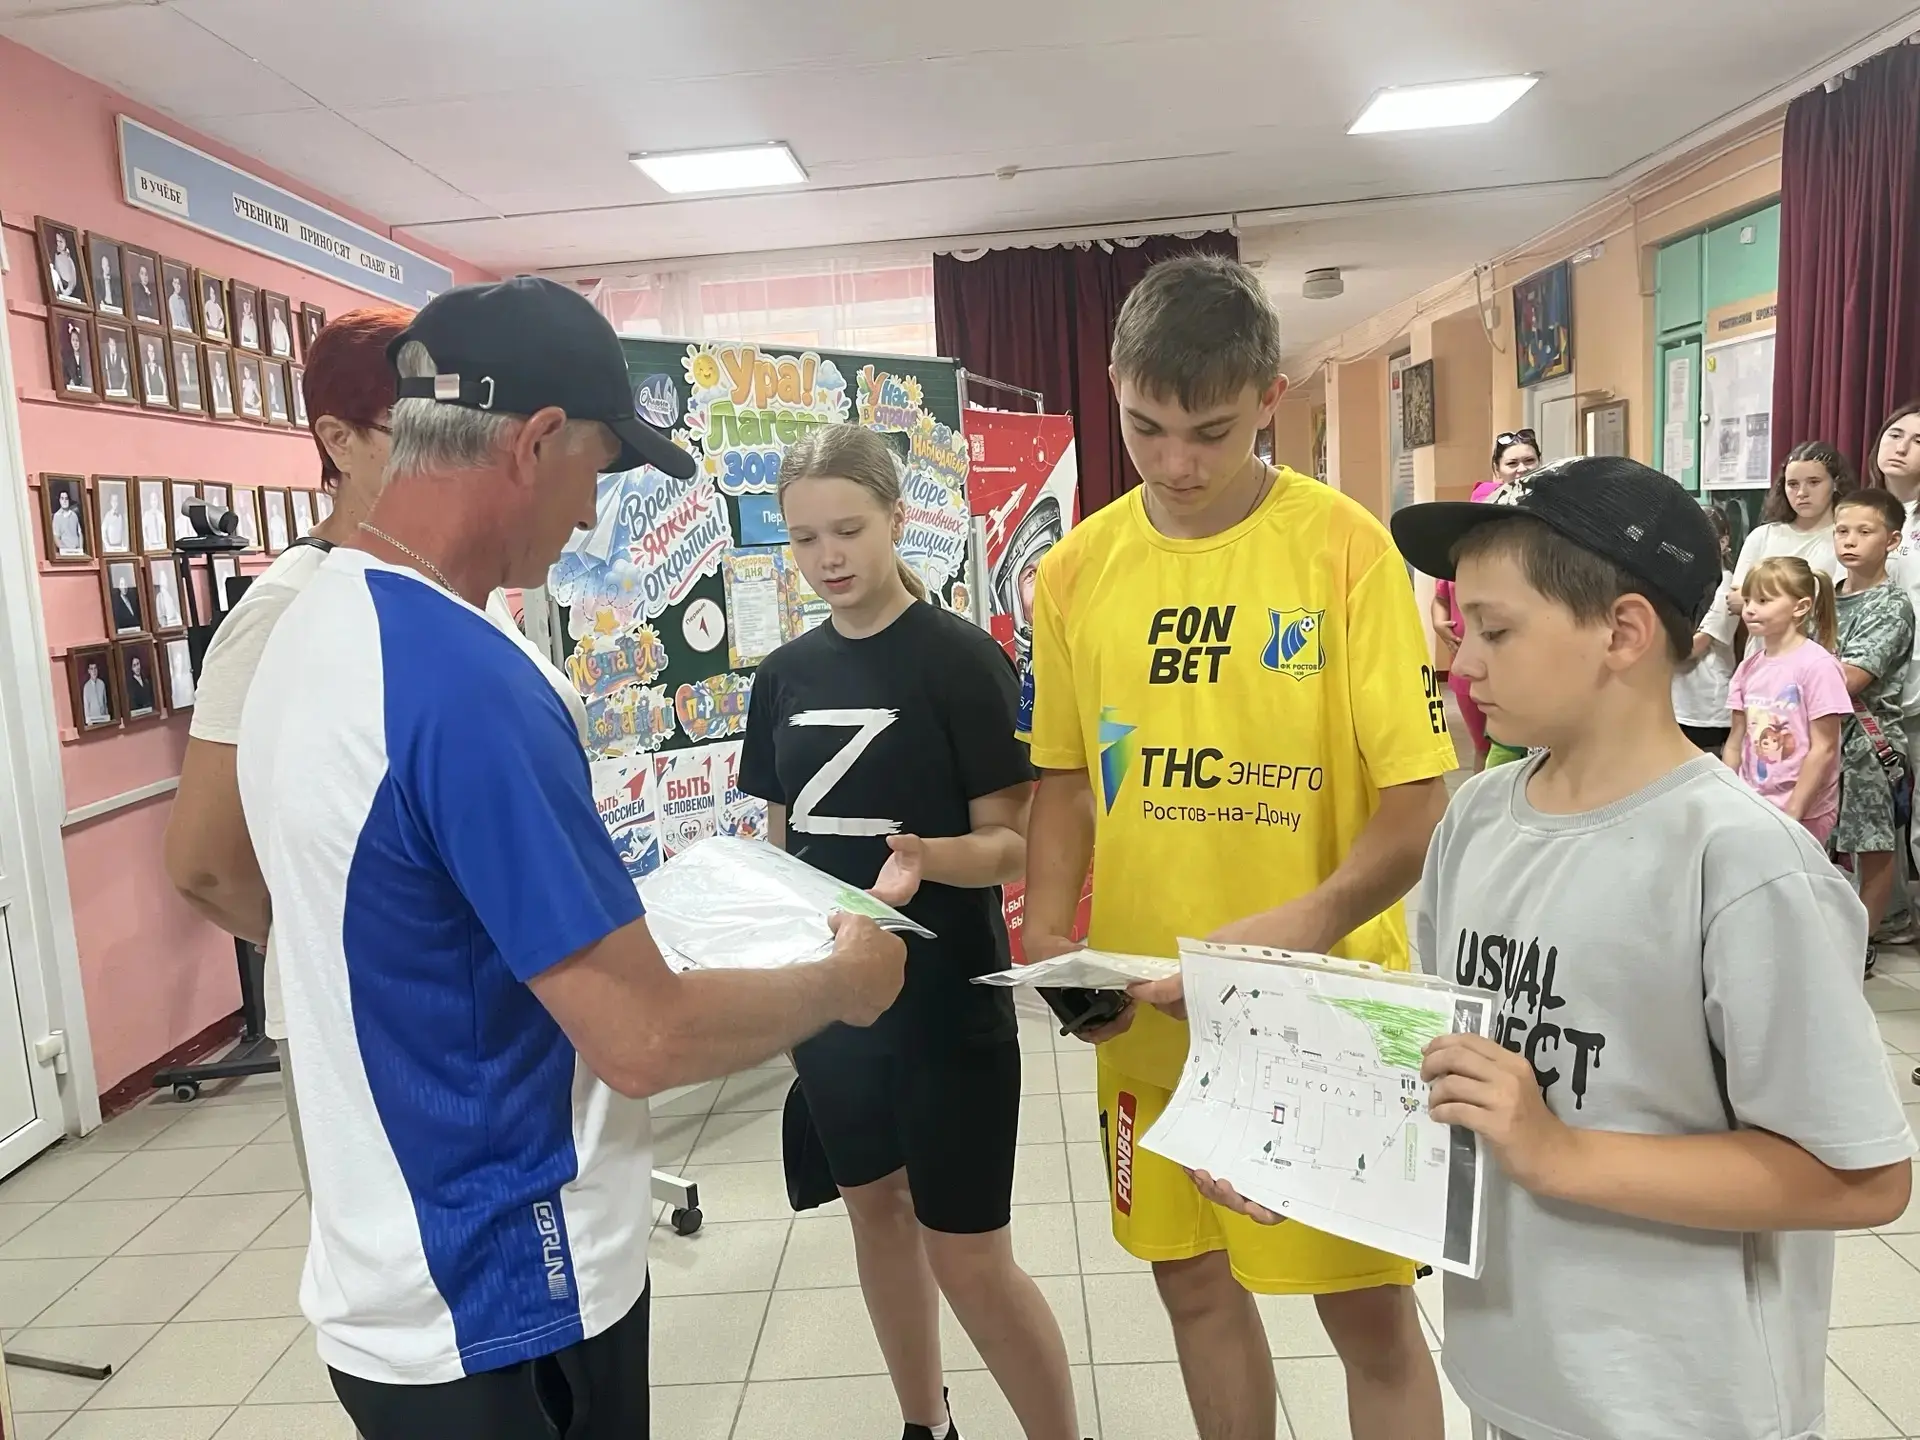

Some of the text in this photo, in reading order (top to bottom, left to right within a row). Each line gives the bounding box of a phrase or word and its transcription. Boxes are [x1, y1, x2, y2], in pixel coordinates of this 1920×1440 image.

[140, 176, 183, 205] В УЧЁБЕ
[233, 196, 401, 281] УЧЕНИКИ ПРИНОСЯТ СЛАВУ ЕЙ
[720, 348, 816, 409] Ура!
[643, 491, 709, 566] ярких
[763, 511, 783, 526] Пер
[904, 506, 964, 535] зитивных
[644, 497, 727, 602] открытий!
[899, 529, 961, 559] моций!
[1147, 604, 1236, 645] FON
[1148, 645, 1231, 685] BET
[666, 775, 711, 801] БЫТЬ
[788, 708, 904, 837] Z
[1141, 746, 1323, 791] ТНС ЭНЕРГО
[597, 795, 619, 814] ЫТЬ
[663, 795, 715, 816] ЧЕЛОВЕКОМ
[1142, 800, 1300, 832] Ростов-на-Дону
[1117, 1105, 1132, 1206] FONBET
